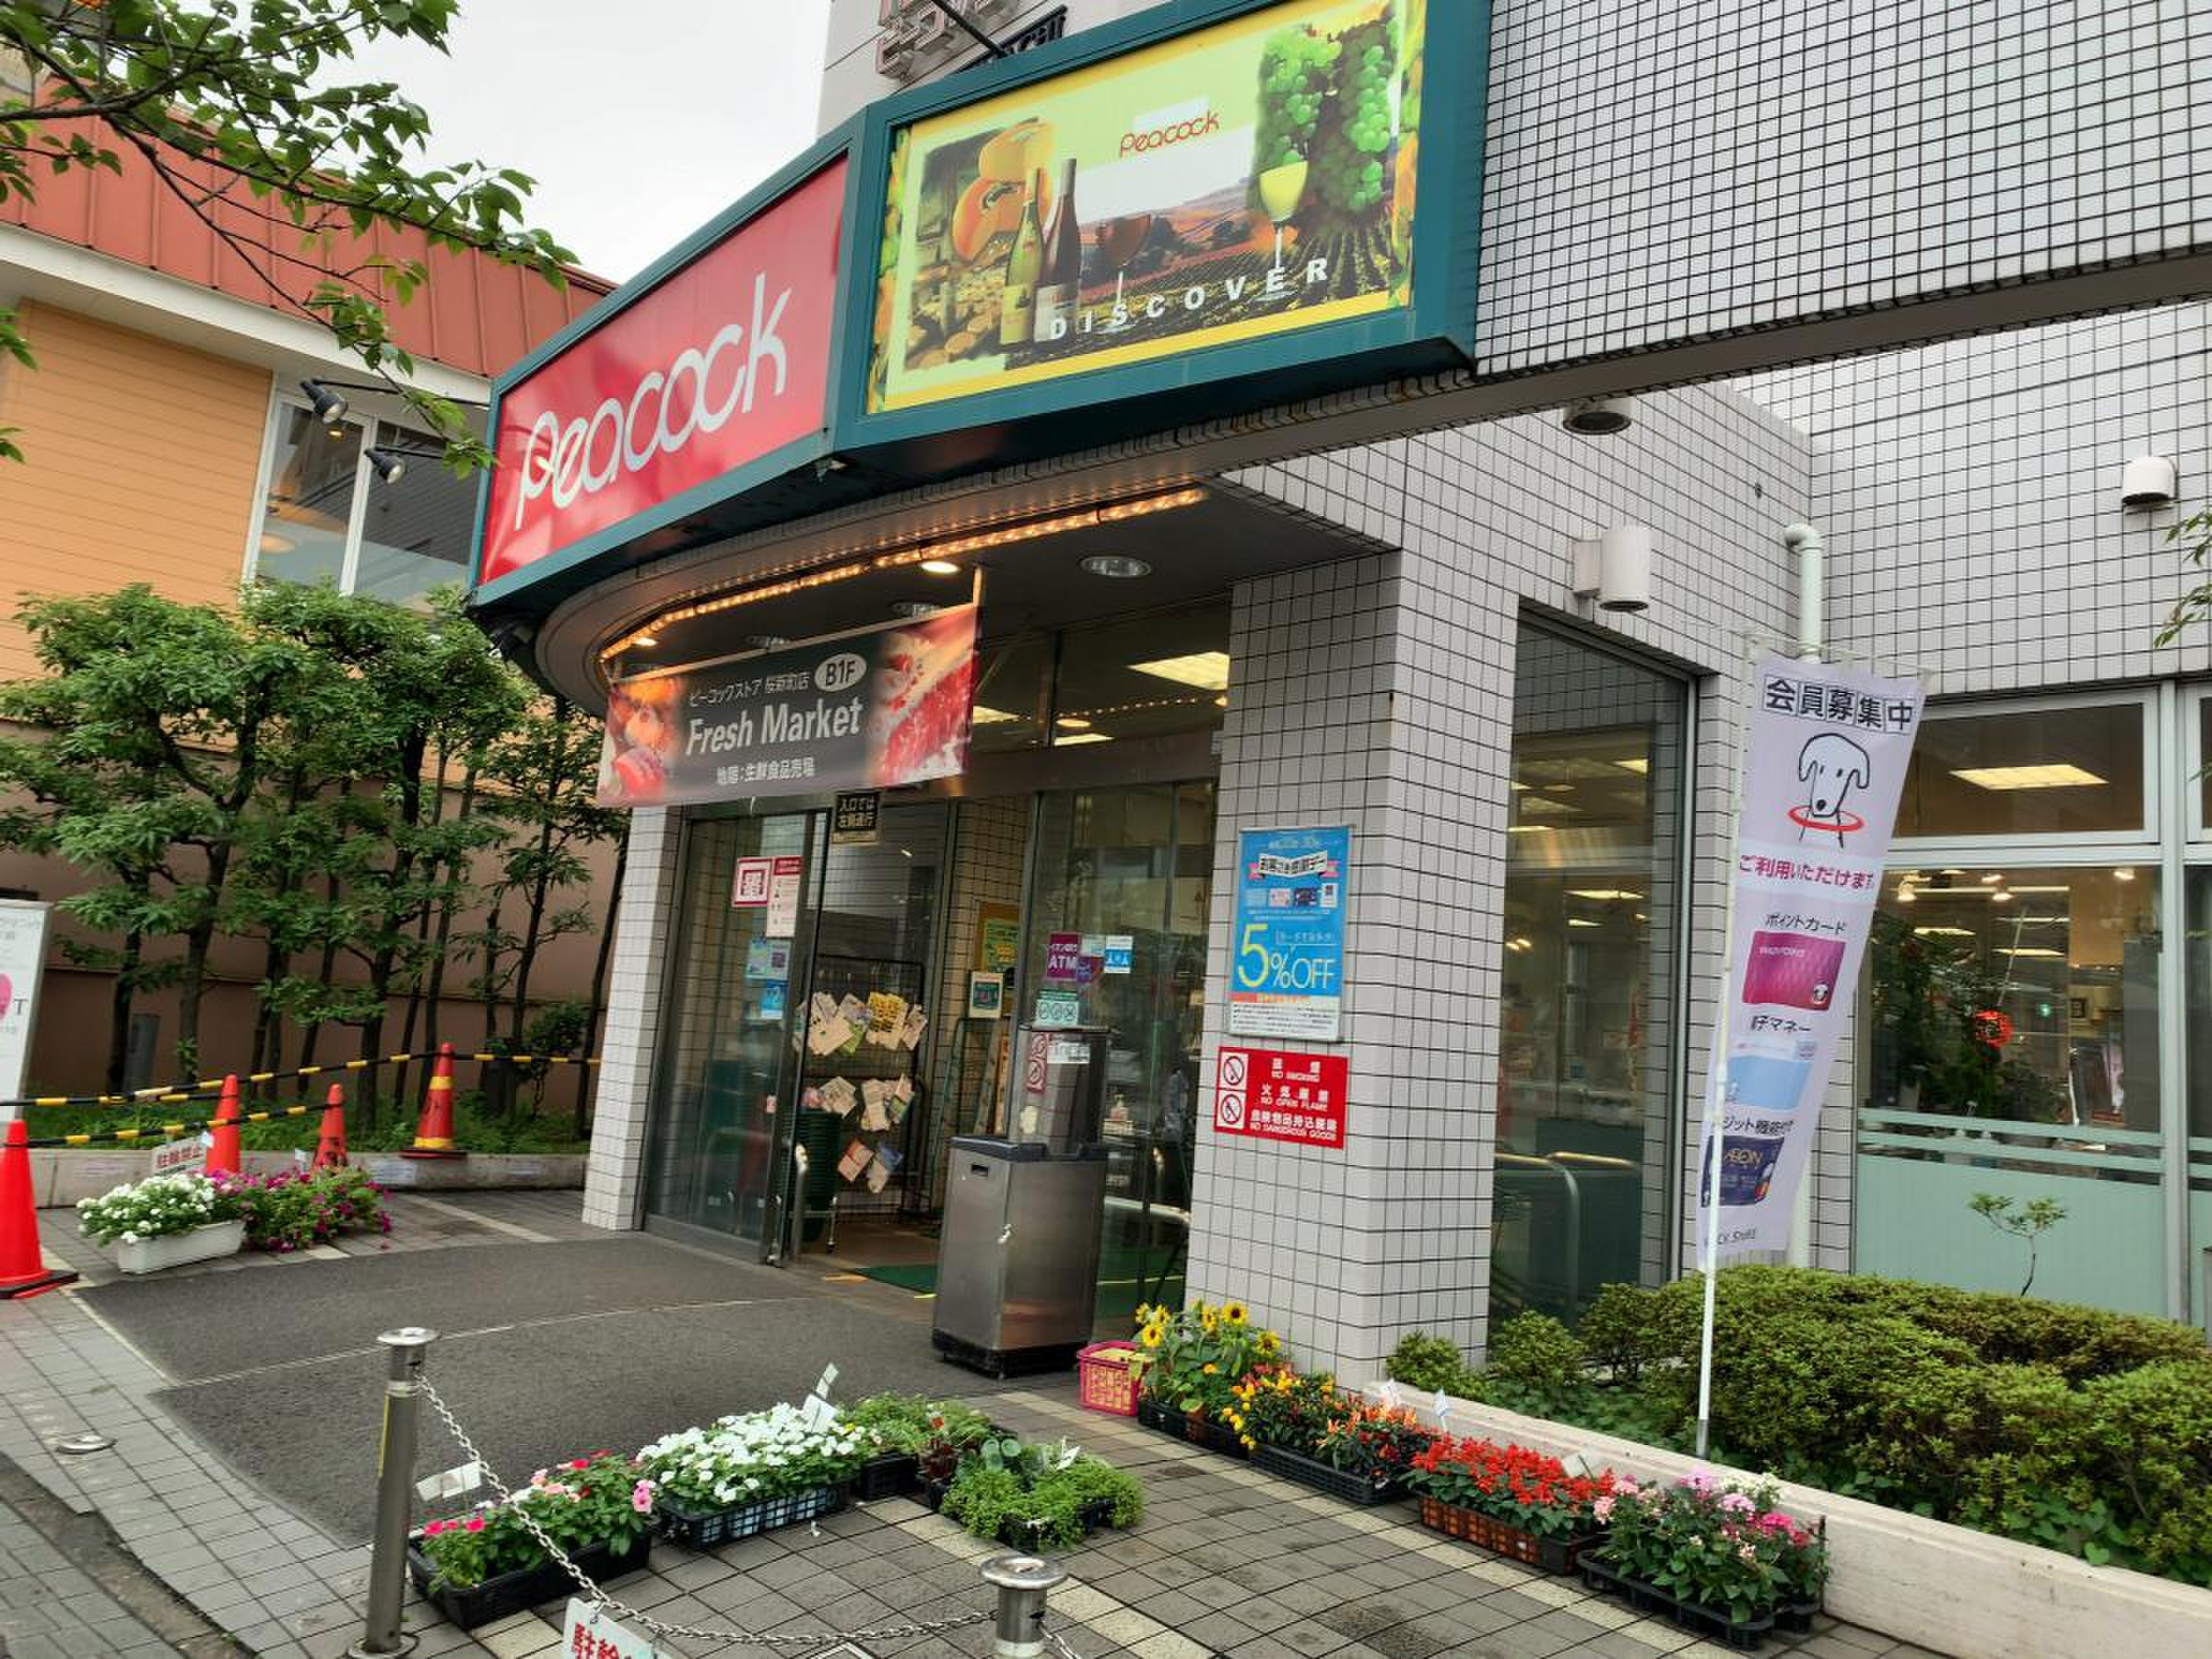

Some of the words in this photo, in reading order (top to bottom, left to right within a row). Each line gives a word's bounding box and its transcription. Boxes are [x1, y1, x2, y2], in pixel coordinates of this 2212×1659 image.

[1050, 257, 1328, 340] DISCOVER
[823, 658, 858, 689] B1F
[1765, 677, 1913, 731] 会員募集中
[686, 711, 753, 756] Fresh
[760, 696, 864, 745] Market
[1765, 913, 1847, 935] ポイントカード
[1048, 954, 1078, 970] ATM
